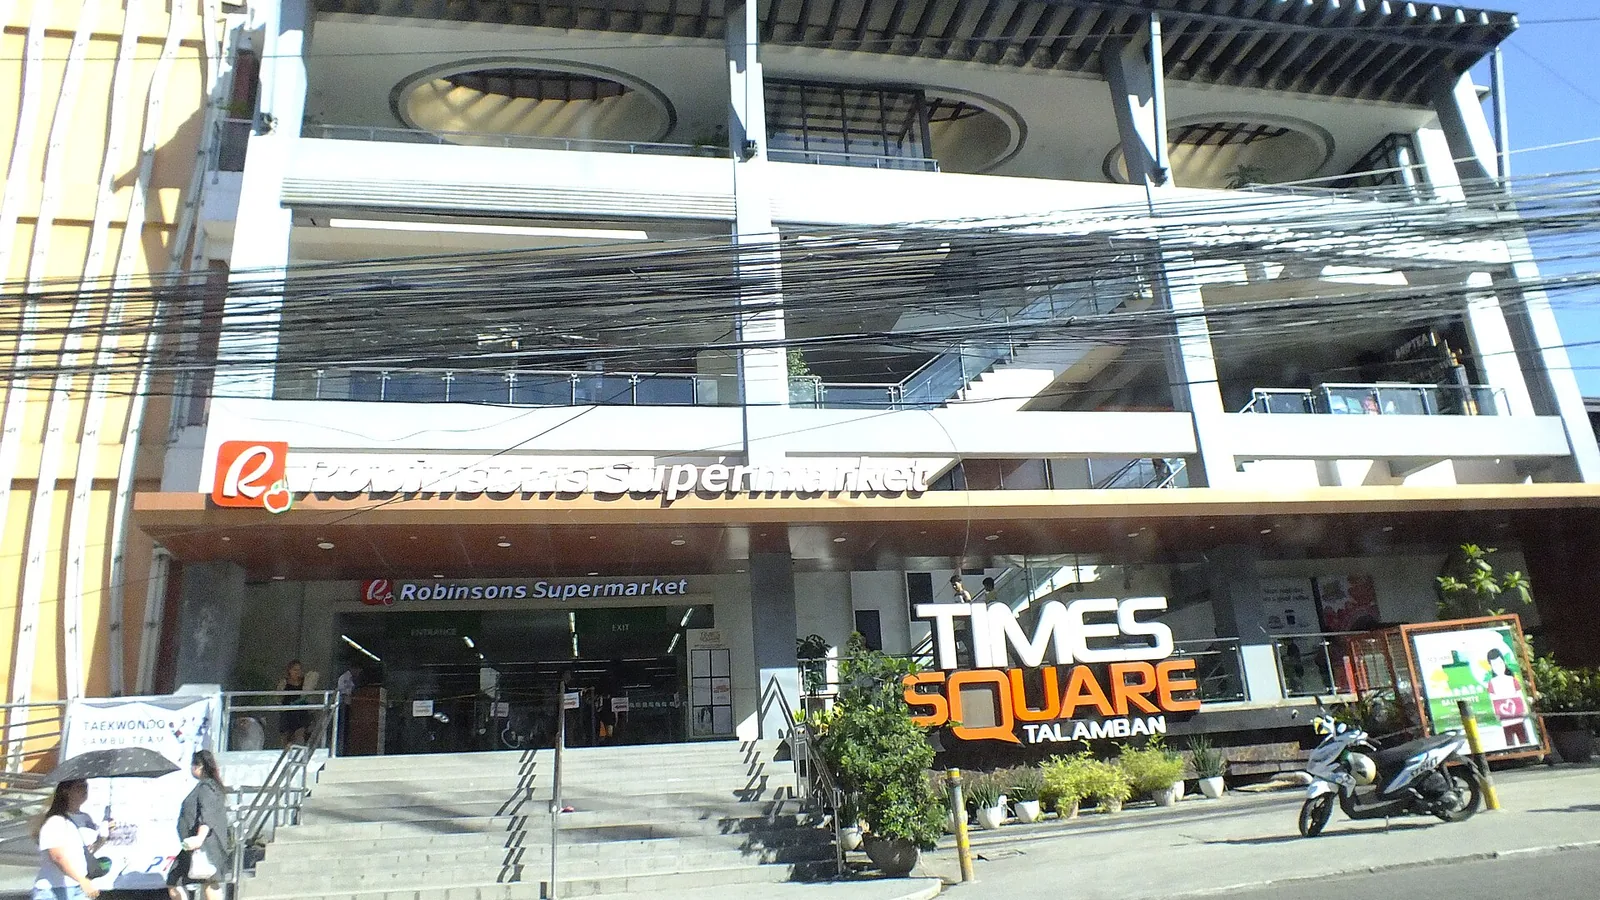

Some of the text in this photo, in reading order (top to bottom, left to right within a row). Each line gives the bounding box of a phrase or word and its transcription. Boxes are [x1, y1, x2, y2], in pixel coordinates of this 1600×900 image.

[598, 456, 929, 500] Supermarket
[401, 579, 687, 601] Robinsons Supermarket
[612, 623, 629, 631] EXIT
[916, 597, 1174, 670] TIMES
[902, 658, 1201, 745] SQUARE
[84, 719, 166, 731] TAEKWONDO
[1023, 715, 1166, 744] TALAMBAN
[132, 736, 165, 744] TEAM
